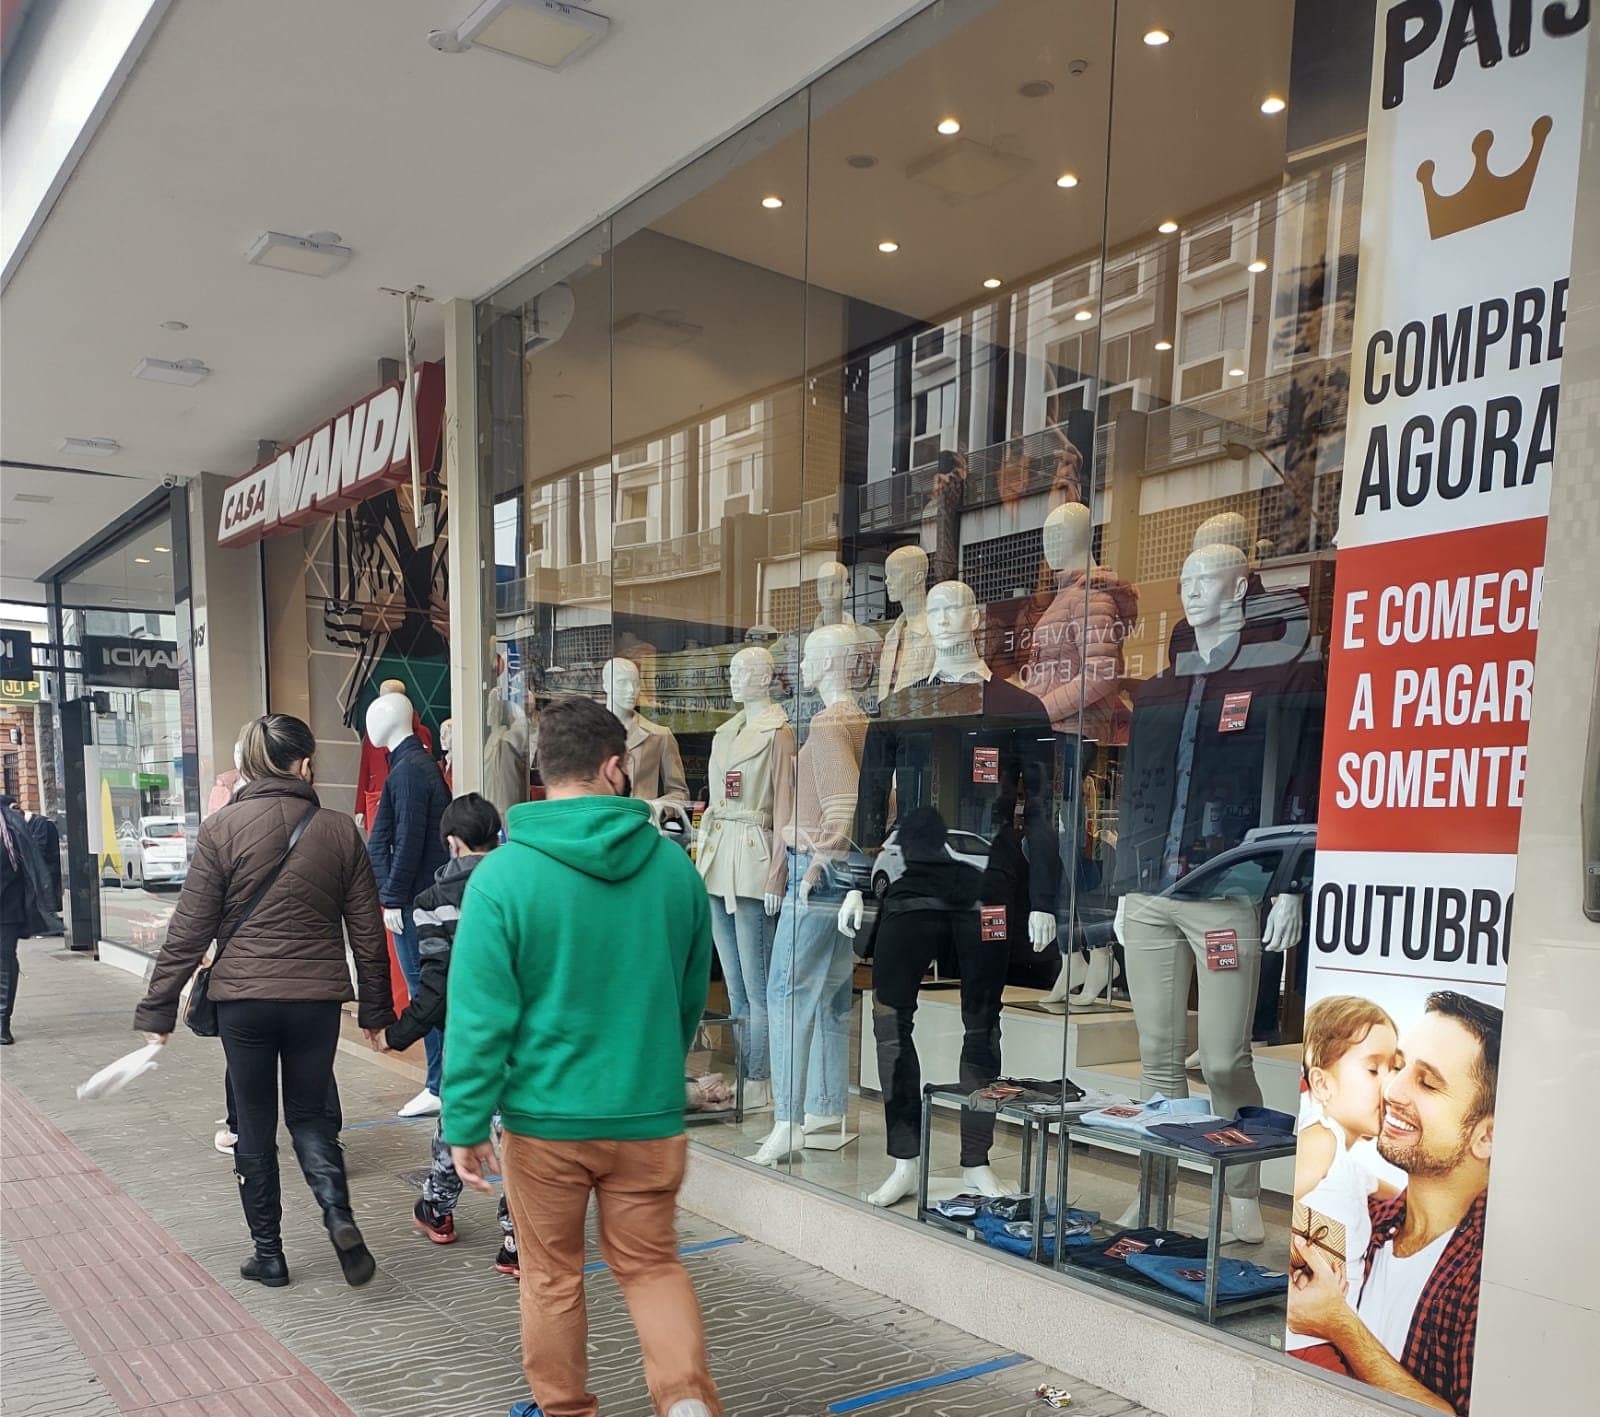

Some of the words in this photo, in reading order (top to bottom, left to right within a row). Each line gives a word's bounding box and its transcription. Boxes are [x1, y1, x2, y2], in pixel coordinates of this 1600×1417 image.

[1364, 278, 1569, 405] COMPRE
[1354, 383, 1560, 516] AGORA
[225, 479, 266, 530] CASA
[1343, 590, 1369, 650] E
[1348, 673, 1374, 731] A
[1391, 659, 1535, 729] PAGAR
[1336, 746, 1528, 810] SOMENTE
[1315, 882, 1515, 967] OUTUBR
